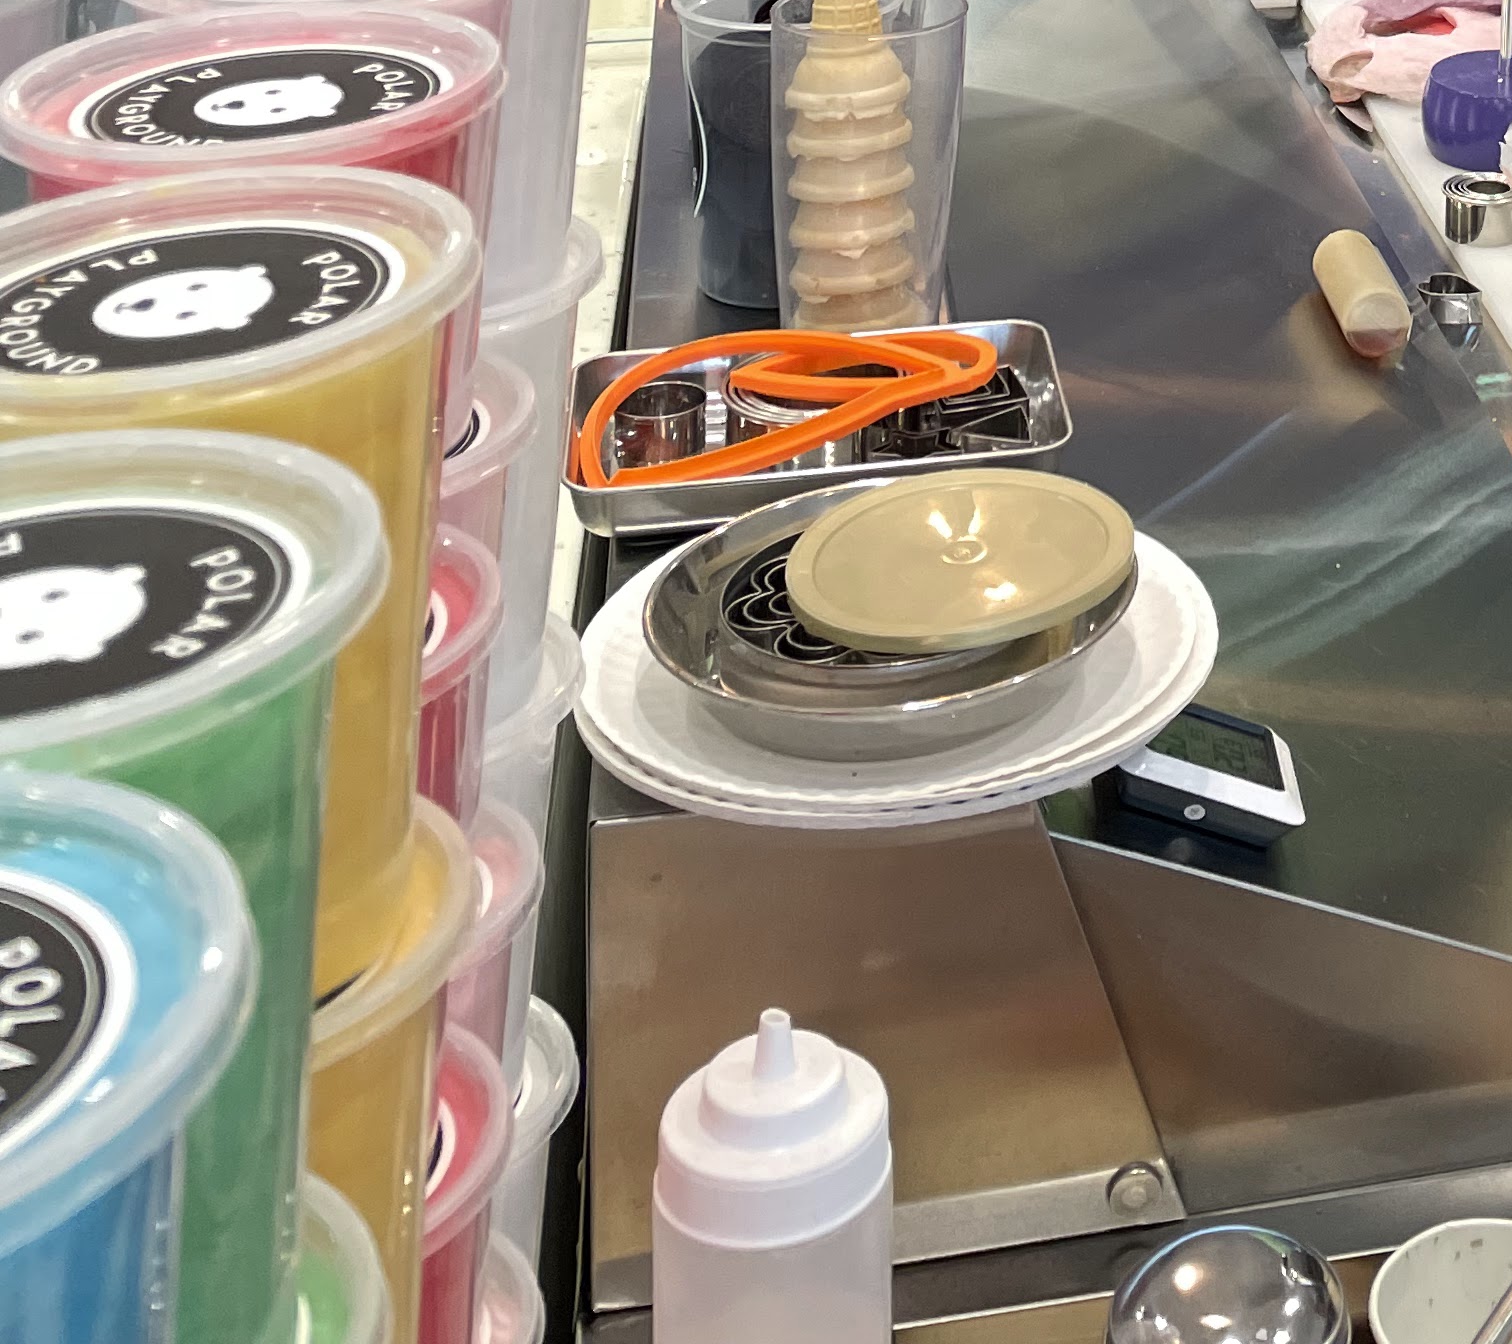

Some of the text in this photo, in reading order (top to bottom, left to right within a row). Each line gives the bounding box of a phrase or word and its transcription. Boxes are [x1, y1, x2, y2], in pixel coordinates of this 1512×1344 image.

[352, 62, 416, 113] POLAR
[0, 247, 161, 376] PLAYGROUND
[288, 249, 363, 327] POLAR
[150, 544, 257, 660] POLAR
